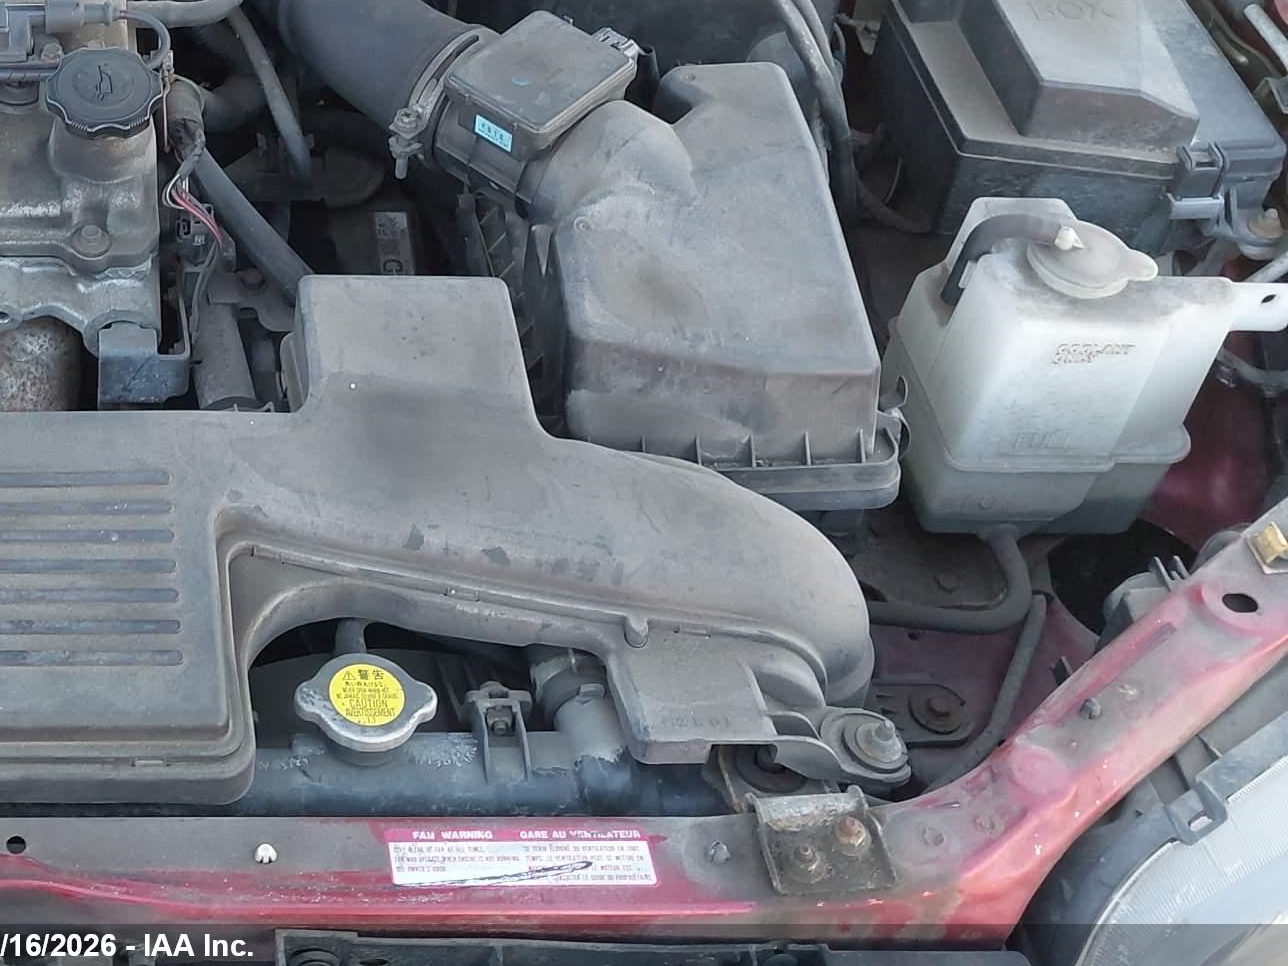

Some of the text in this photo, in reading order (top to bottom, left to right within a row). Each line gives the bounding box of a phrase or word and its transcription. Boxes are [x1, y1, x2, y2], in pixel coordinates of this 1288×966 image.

[1026, 0, 1117, 21] BOX
[1054, 342, 1136, 356] COOLANT
[349, 699, 388, 708] CAUTION
[412, 831, 435, 840] FAN
[441, 830, 494, 840] WARNING
[519, 830, 548, 840] GARE
[552, 830, 567, 840] AU
